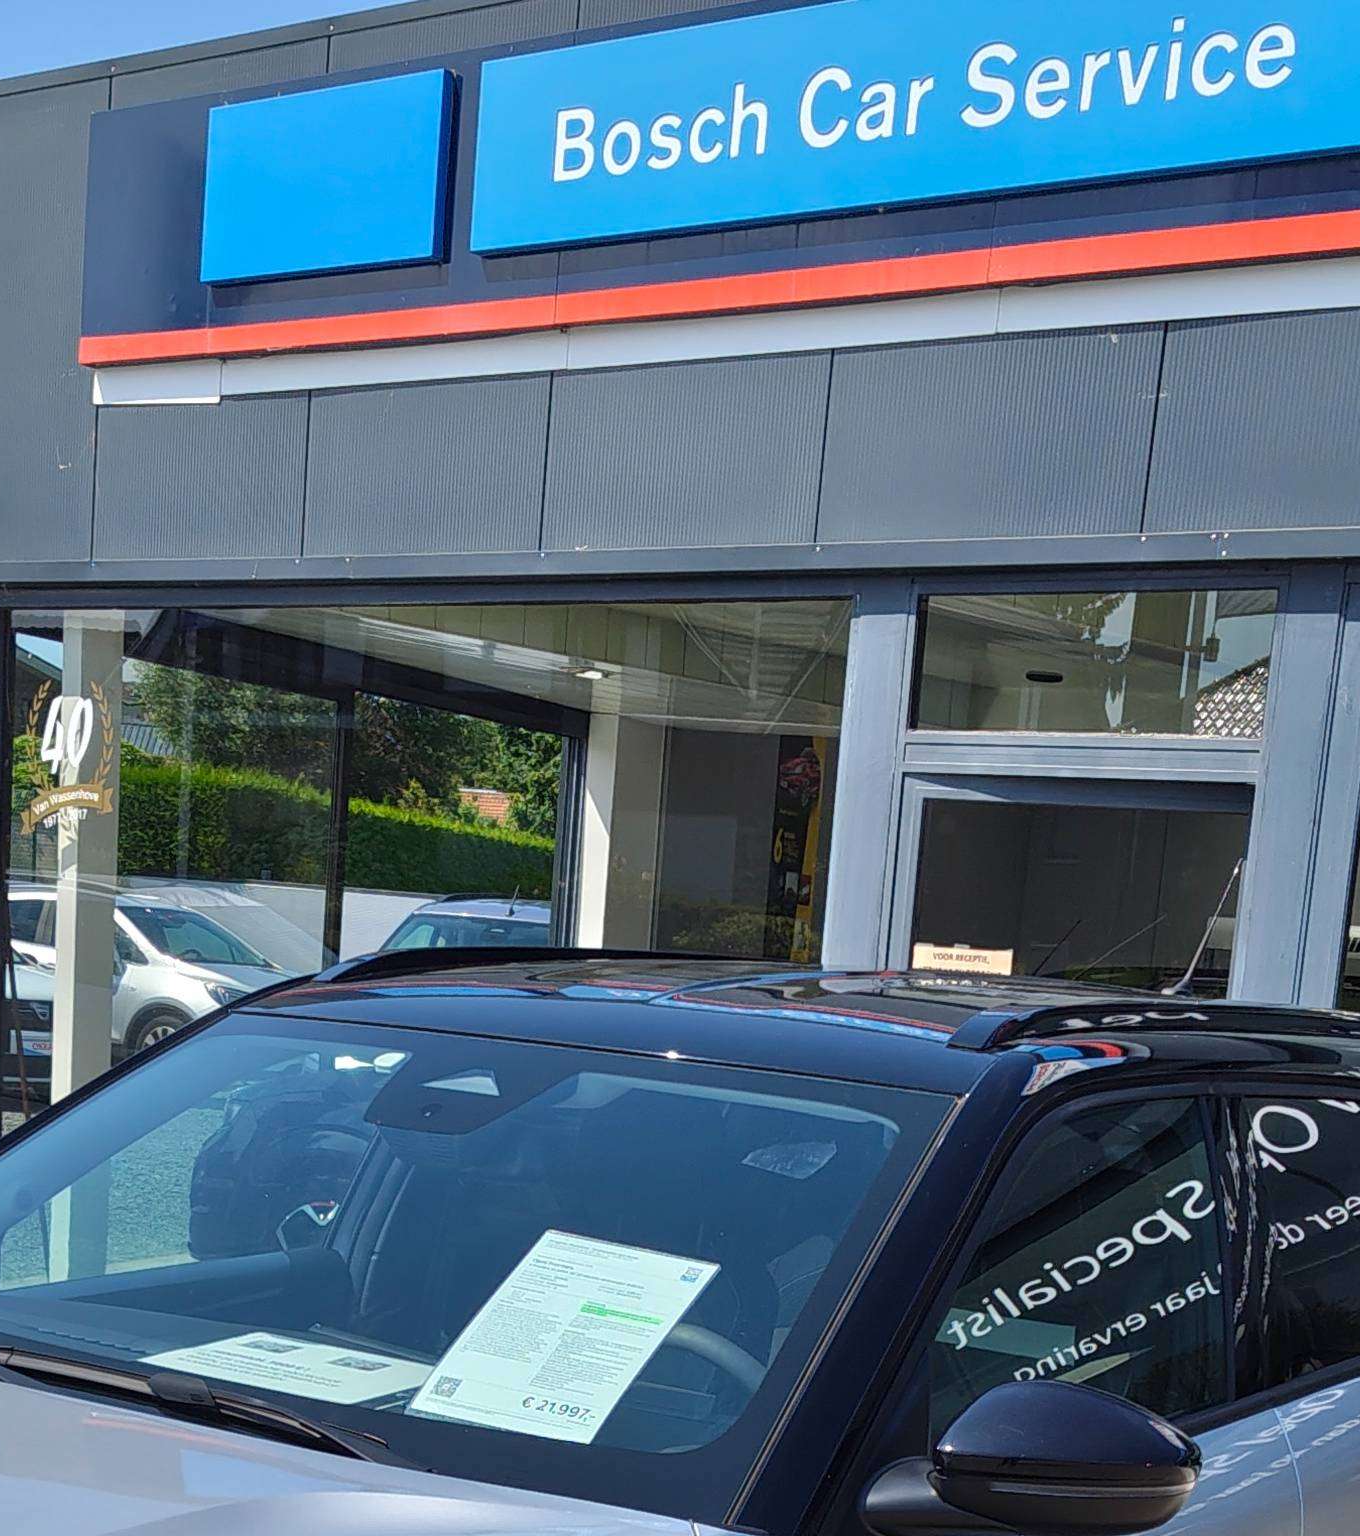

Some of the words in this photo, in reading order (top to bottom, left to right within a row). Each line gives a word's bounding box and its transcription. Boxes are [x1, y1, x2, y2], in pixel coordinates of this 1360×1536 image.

[552, 83, 768, 183] Bosch
[798, 66, 934, 148] Car
[960, 16, 1297, 129] Service
[41, 696, 93, 774] 40
[32, 800, 50, 816] Van
[522, 1396, 535, 1409] €
